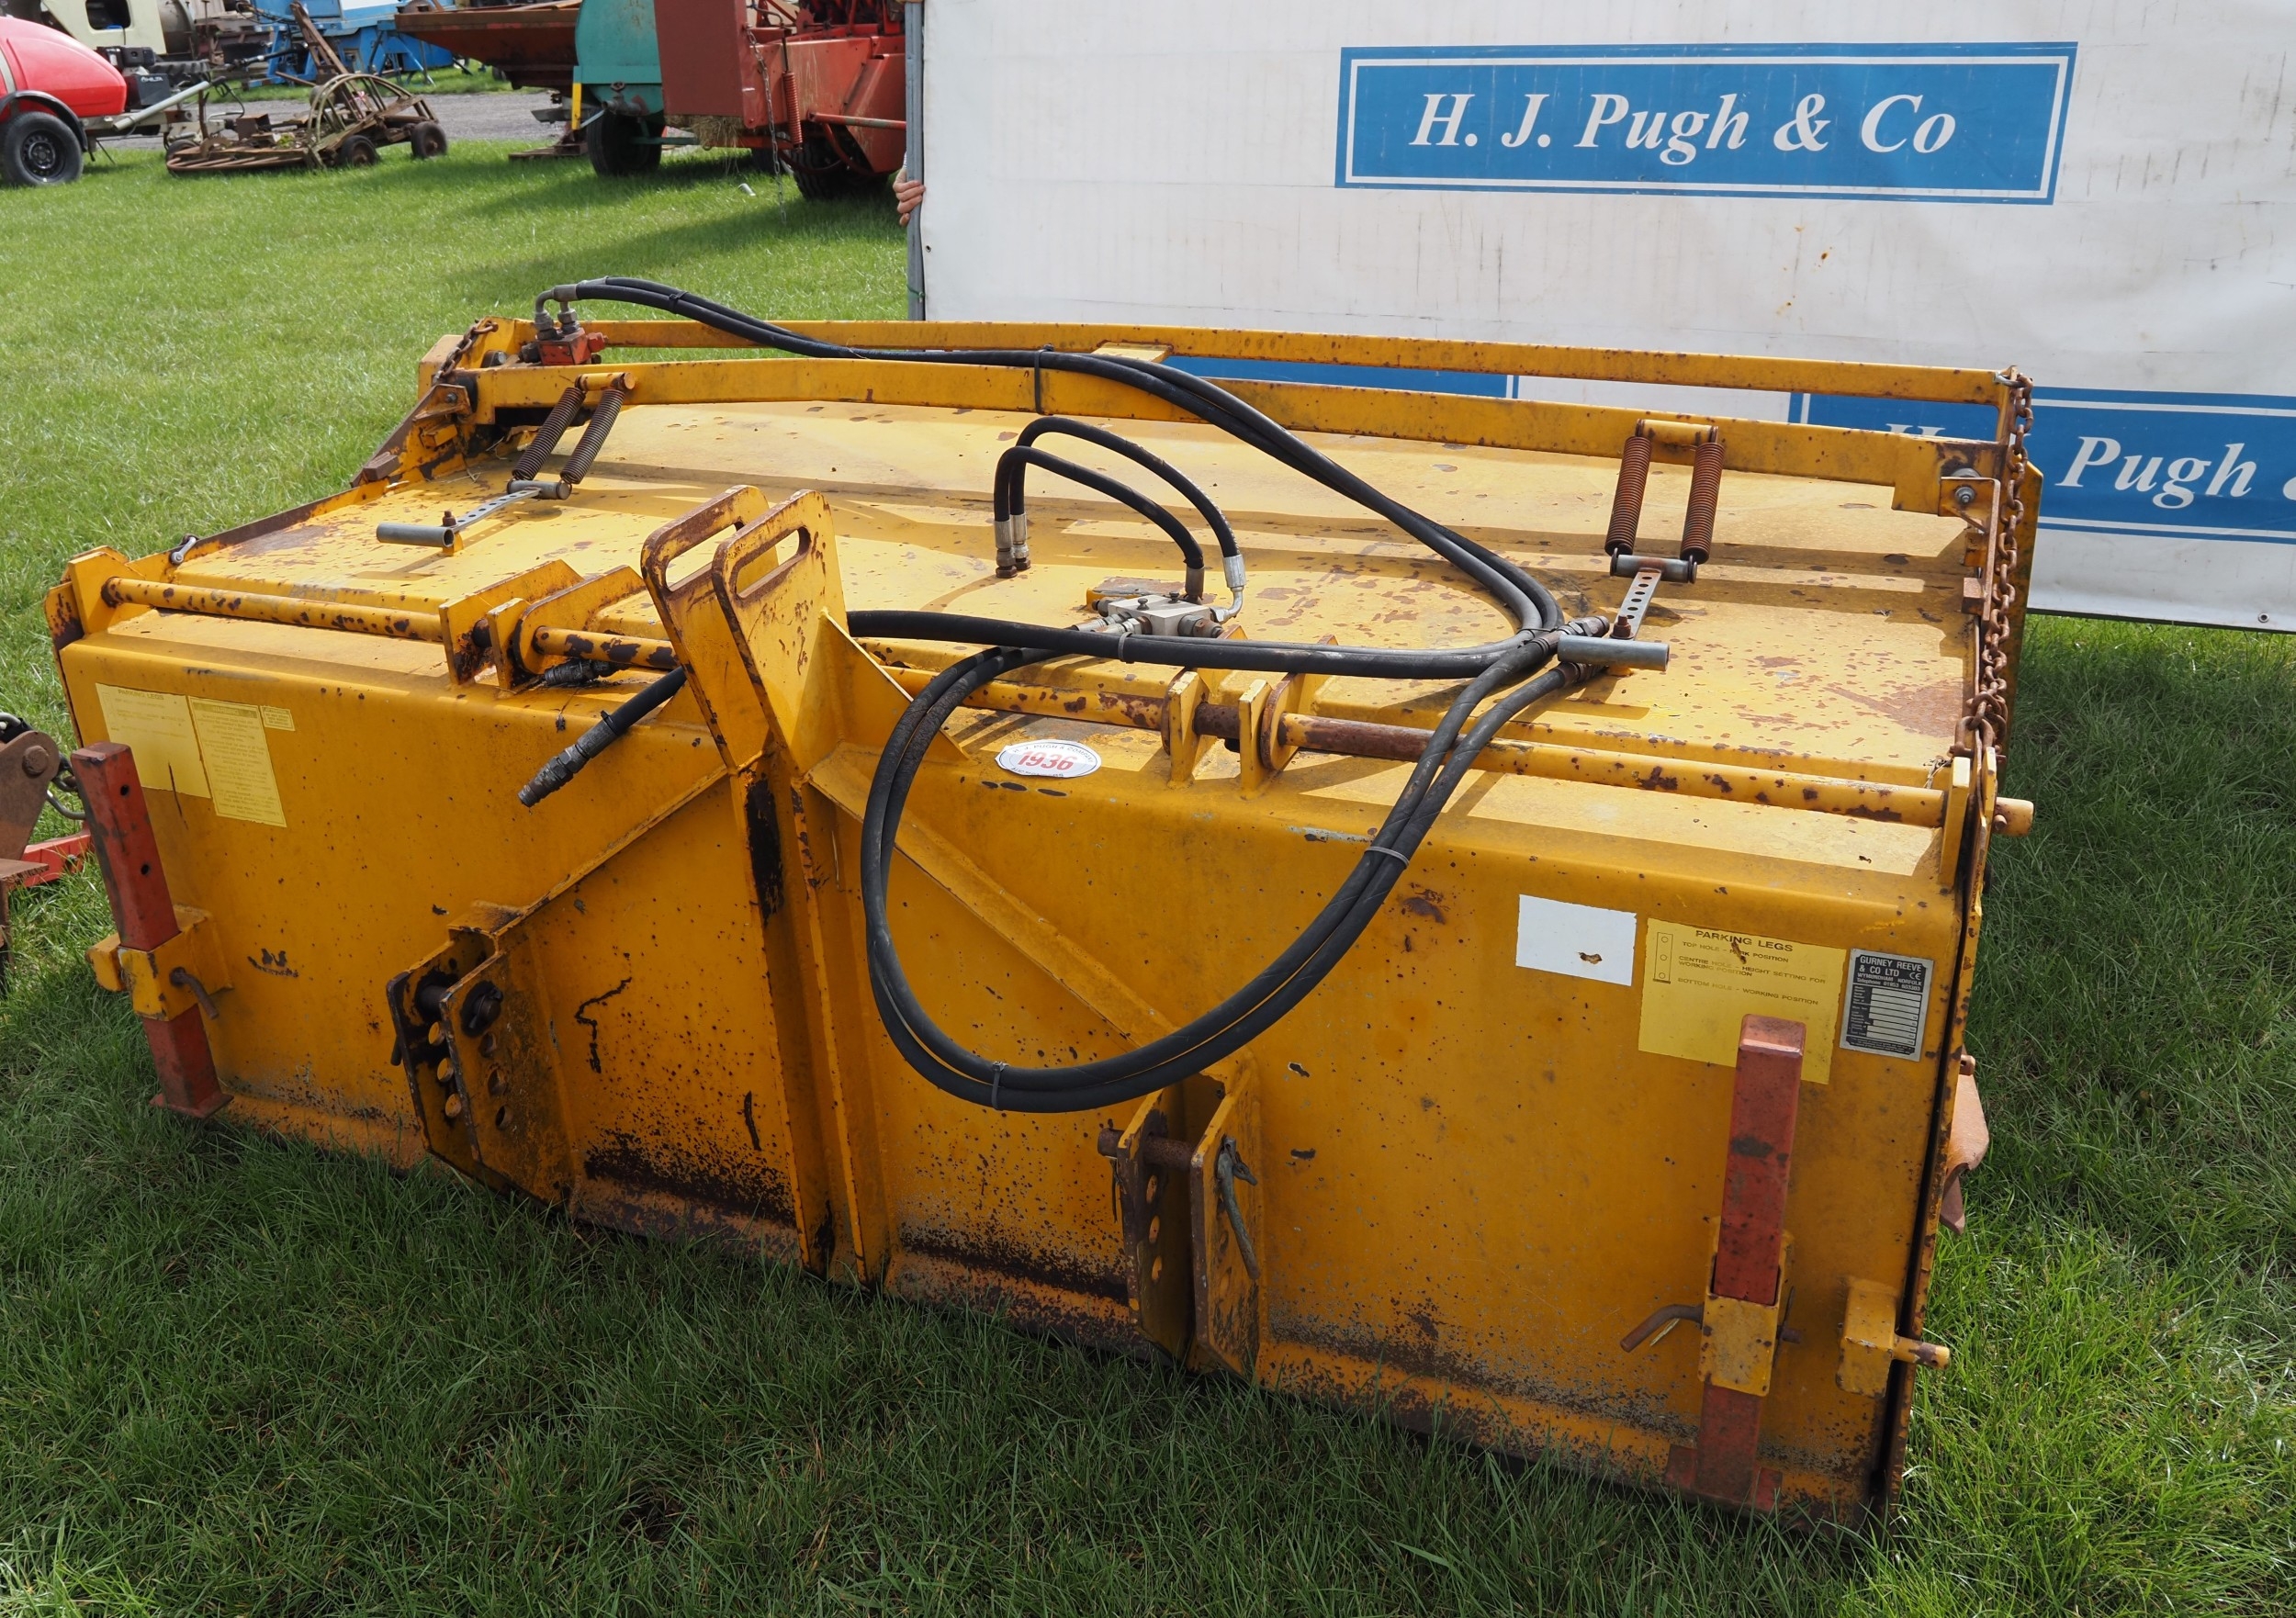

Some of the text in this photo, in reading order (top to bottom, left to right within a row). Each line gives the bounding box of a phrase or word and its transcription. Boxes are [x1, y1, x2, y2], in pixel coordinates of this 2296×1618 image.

[1408, 91, 1957, 166] H. J. Pugh & Co
[2054, 435, 2257, 509] Pugh
[1018, 750, 1077, 770] 1936
[1695, 929, 1794, 952] PARKING LEGS
[1699, 944, 1720, 952] HOLE
[1752, 952, 1789, 963] POSITION
[1860, 955, 1922, 972] GURNEY REEVE
[1679, 955, 1710, 965] CENTRE
[1711, 961, 1732, 969] HOLE
[1742, 966, 1772, 975] HEIGHT
[1773, 971, 1806, 981] SETTING
[1679, 961, 1753, 977] WORKING POSITION
[1859, 964, 1900, 977] & CO LTD
[1677, 977, 1710, 987] BOTTOM
[1712, 983, 1733, 991] HOLE
[1742, 988, 1779, 999] WORKING
[1782, 994, 1818, 1006] POSITION
